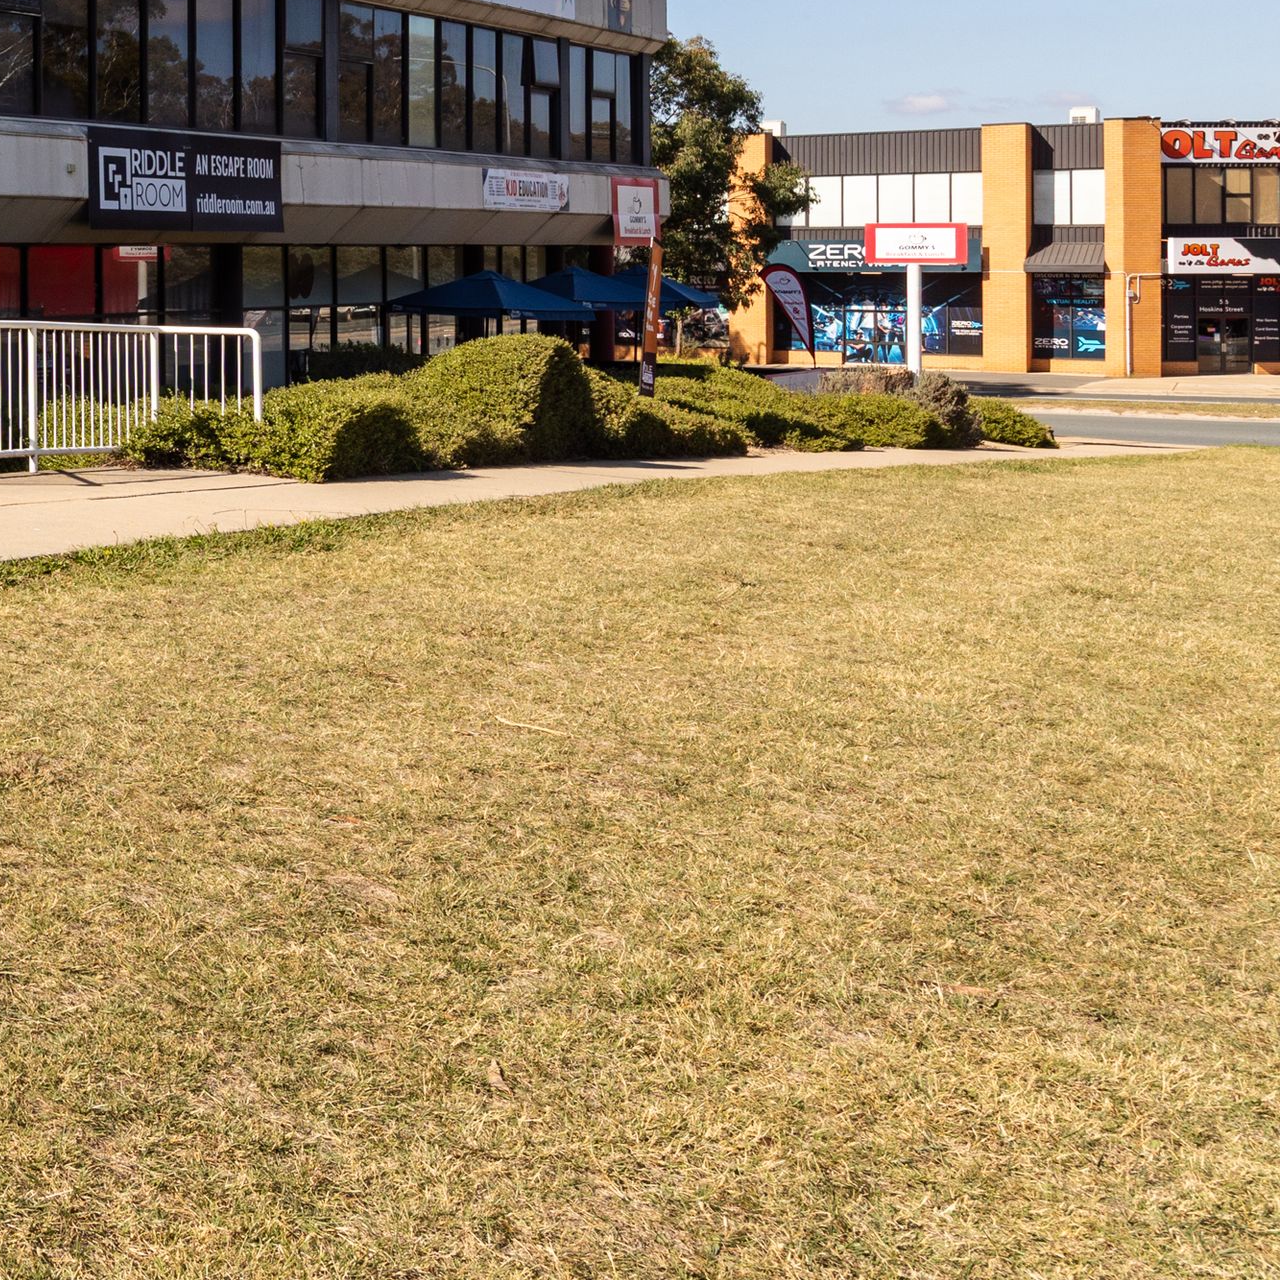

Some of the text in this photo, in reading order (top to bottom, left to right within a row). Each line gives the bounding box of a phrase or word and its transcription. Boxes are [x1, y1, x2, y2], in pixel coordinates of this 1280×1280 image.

[1161, 129, 1238, 159] OLT
[131, 148, 186, 177] RIDDLE
[195, 154, 274, 179] AN ESCAPE ROOM
[136, 182, 184, 207] ROOM
[518, 179, 549, 198] EDUCATION
[196, 193, 276, 216] riddleroom.com.au
[808, 244, 866, 259] ZER
[1181, 243, 1220, 257] JOLT
[1206, 255, 1251, 267] Games
